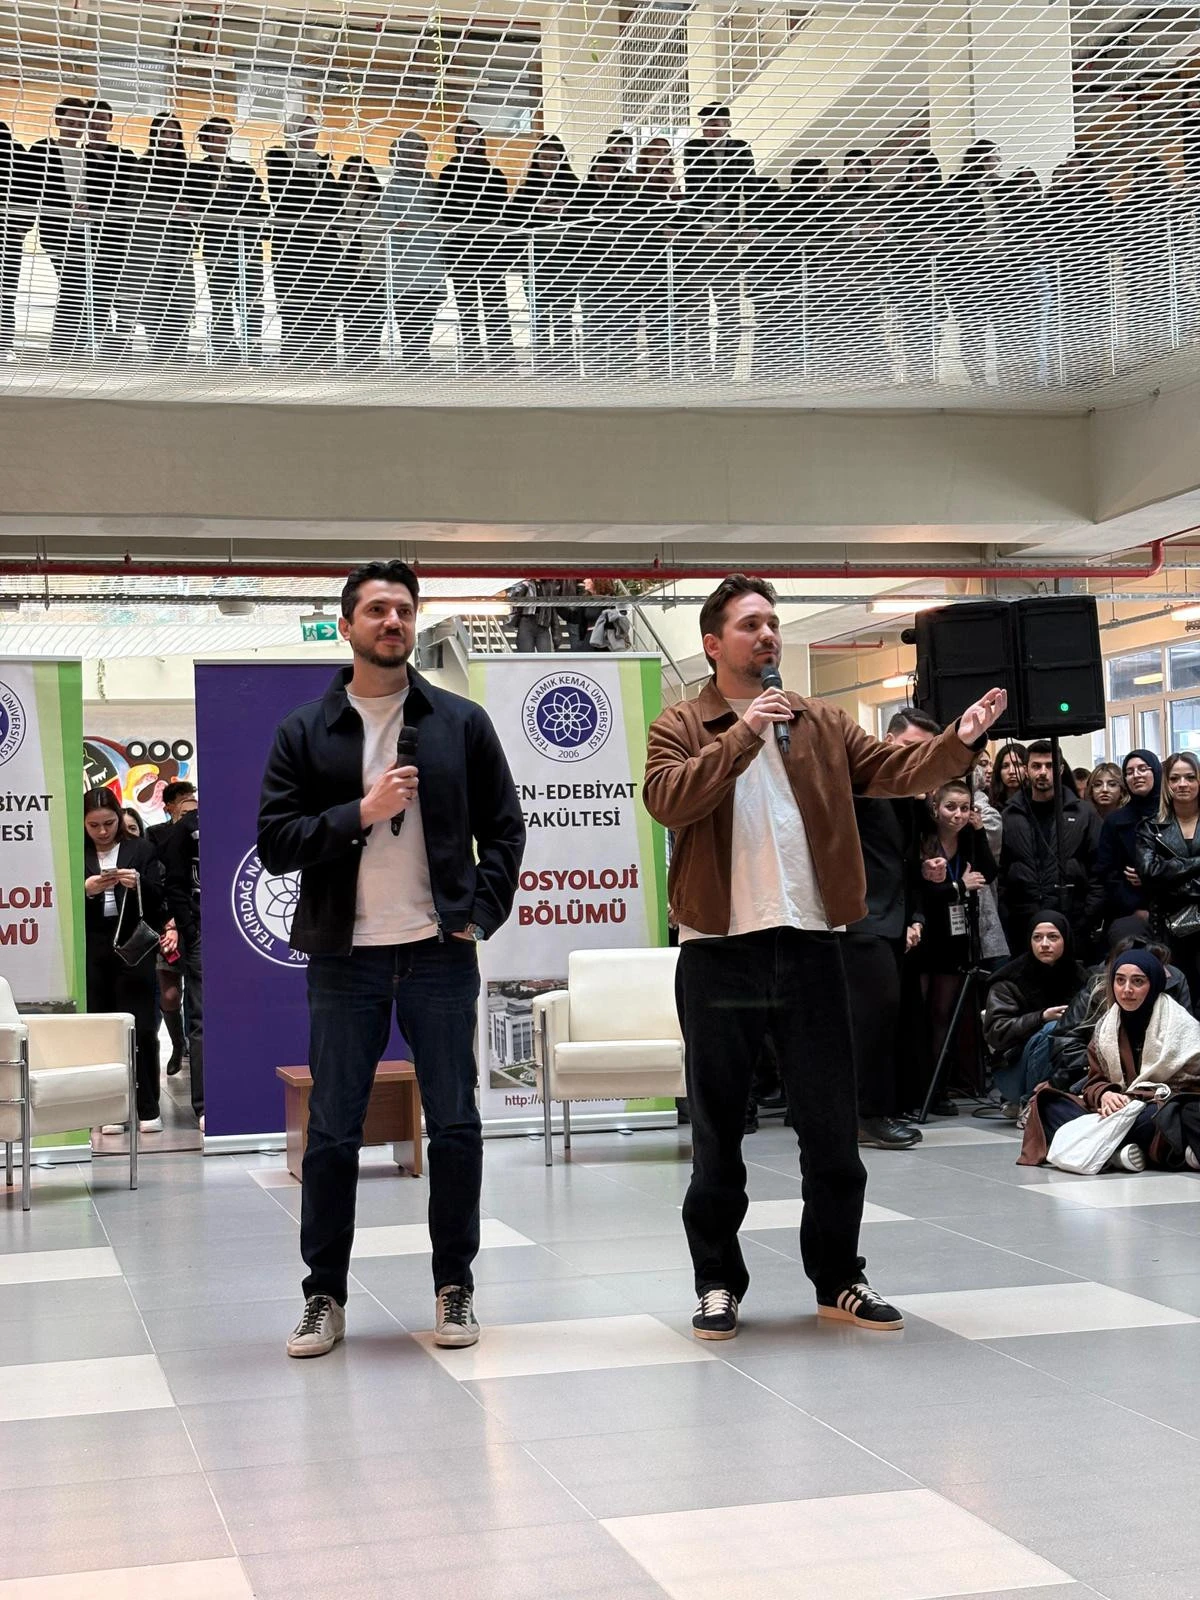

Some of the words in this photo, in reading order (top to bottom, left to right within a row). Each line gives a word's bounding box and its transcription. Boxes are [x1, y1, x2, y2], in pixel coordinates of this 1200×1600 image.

[530, 678, 557, 703] NAMIK
[558, 676, 591, 692] KEMAL
[526, 705, 549, 751] TEKİRDAĞ
[588, 688, 608, 750] ÜNİVERSİTESİ
[558, 750, 580, 759] 2006
[515, 780, 637, 800] N-EDEBİYAT
[0, 820, 34, 841] ESİ
[246, 856, 263, 877] NA
[519, 864, 638, 891] OSYOLOJİ
[239, 880, 275, 951] TEKİRDAĞ
[518, 898, 627, 925] BÖLÜMÜ
[288, 948, 312, 961] 20
